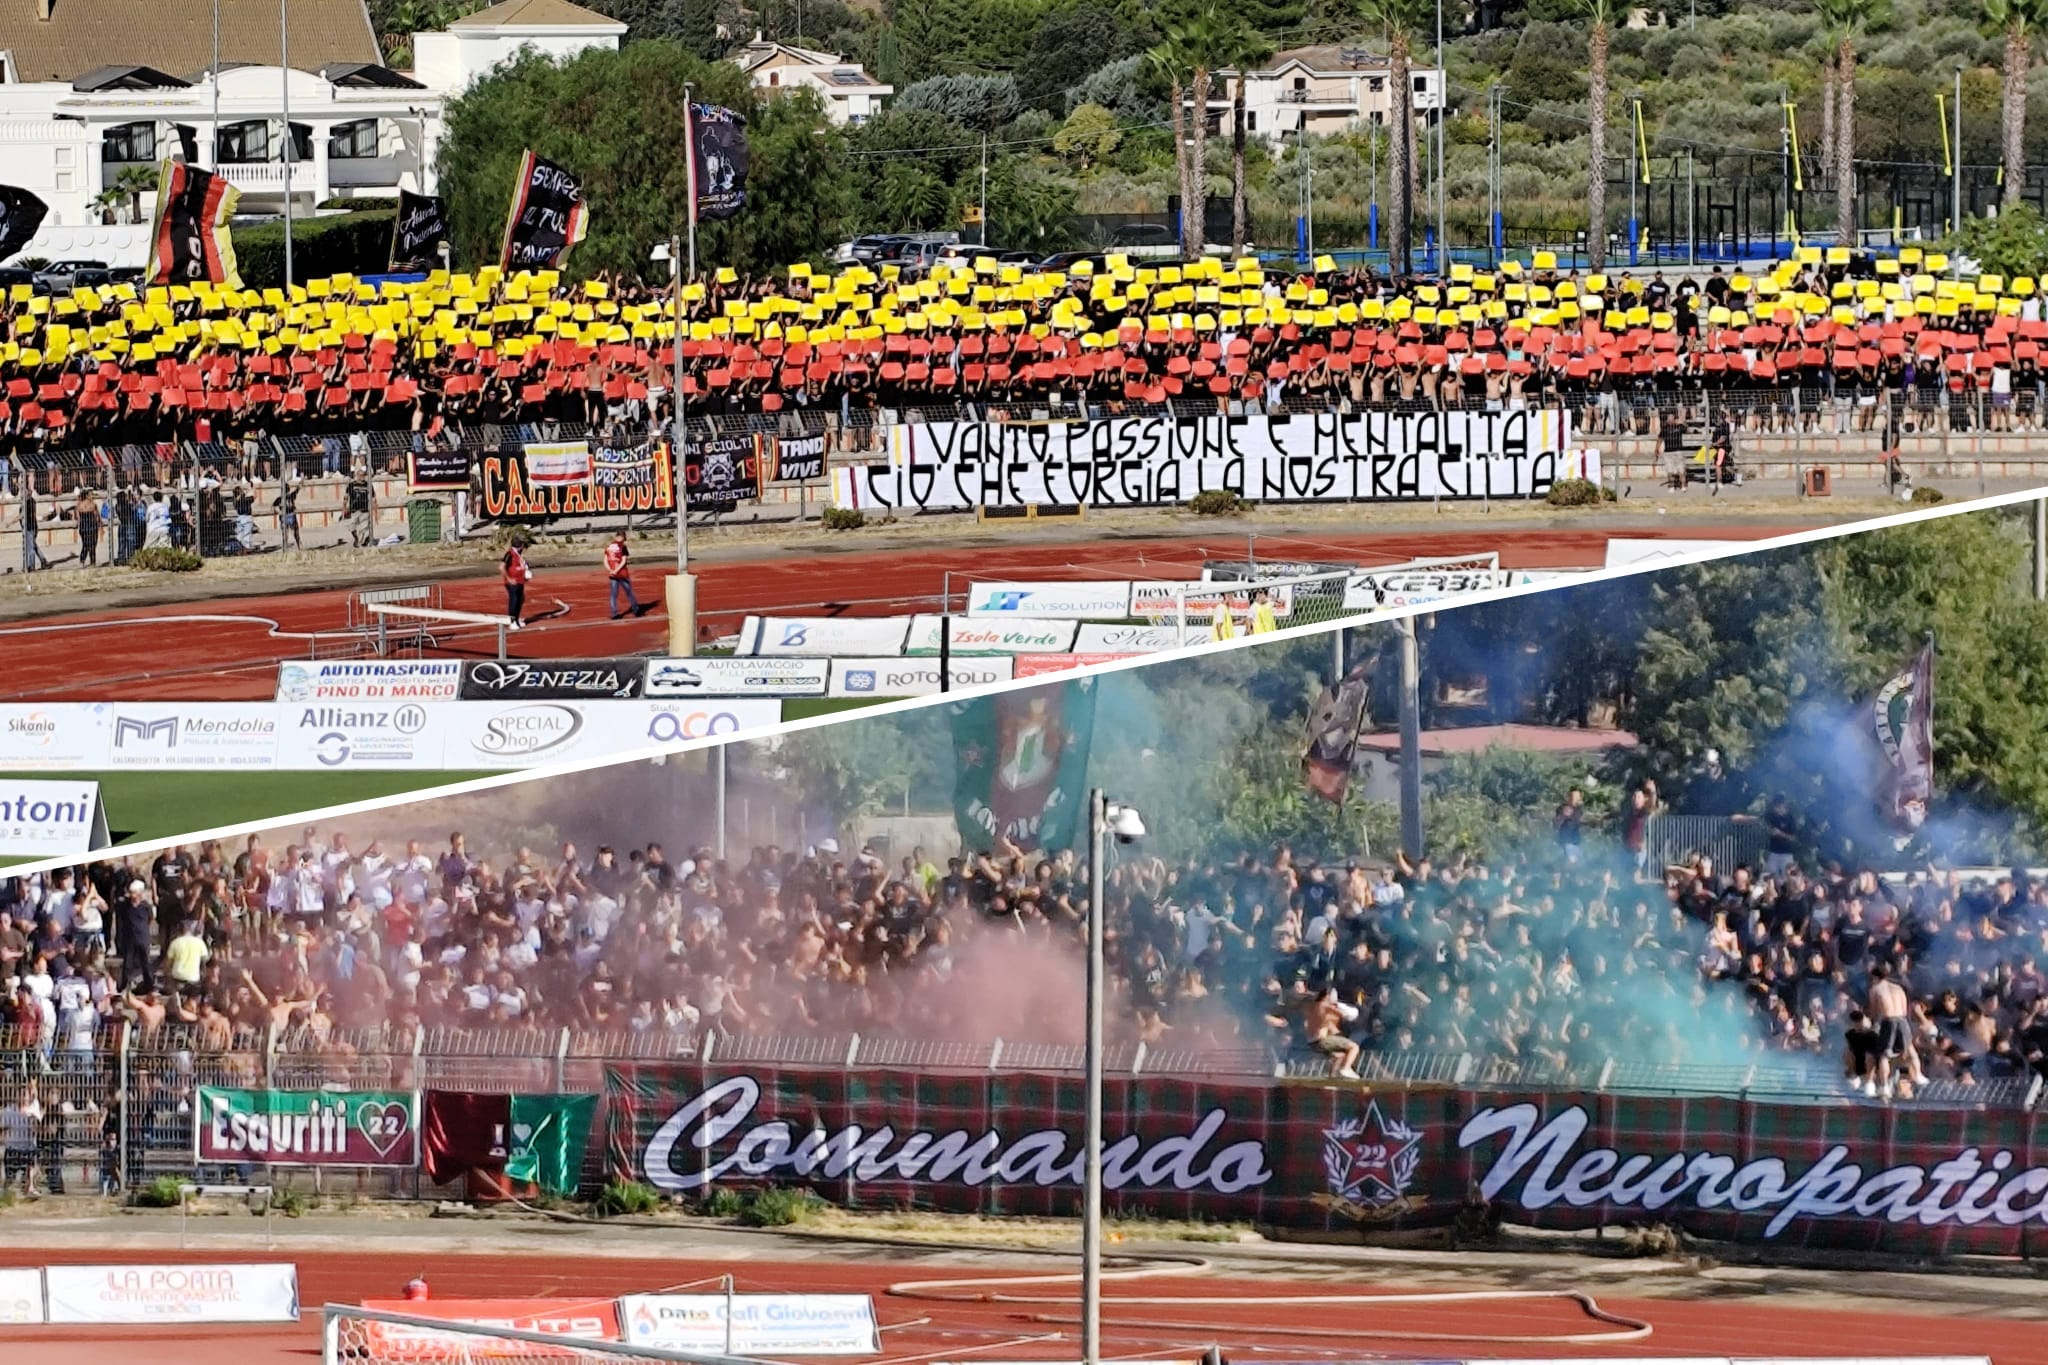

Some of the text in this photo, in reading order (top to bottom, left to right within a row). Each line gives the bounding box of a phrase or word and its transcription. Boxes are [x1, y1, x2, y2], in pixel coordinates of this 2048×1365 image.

[704, 437, 753, 453] SCIOLTI
[1066, 414, 1249, 462] PASSIONE
[1268, 415, 1291, 456] E
[780, 460, 821, 479] VIVE
[954, 462, 1028, 507] CHE
[1043, 459, 1181, 504] FORGIA
[1198, 455, 1245, 500] LA
[1262, 454, 1419, 498] NOSTRA
[1137, 586, 1170, 598] new
[1021, 600, 1127, 612] SLYSOLUTION
[1003, 630, 1058, 646] Verde
[320, 663, 458, 677] AUTOTRASPORTI
[706, 660, 805, 670] AUTOLAVAGGIO
[471, 662, 620, 690] VENEZIA
[886, 670, 998, 686] ROTOOLD
[316, 684, 455, 697] PINO DI MARCO
[184, 716, 275, 734] Mendolia
[299, 707, 389, 728] Allianz
[369, 1116, 399, 1136] 22
[643, 1075, 1273, 1193] Commando
[1355, 1144, 1388, 1168] 22
[107, 1270, 234, 1291] LA PORTA
